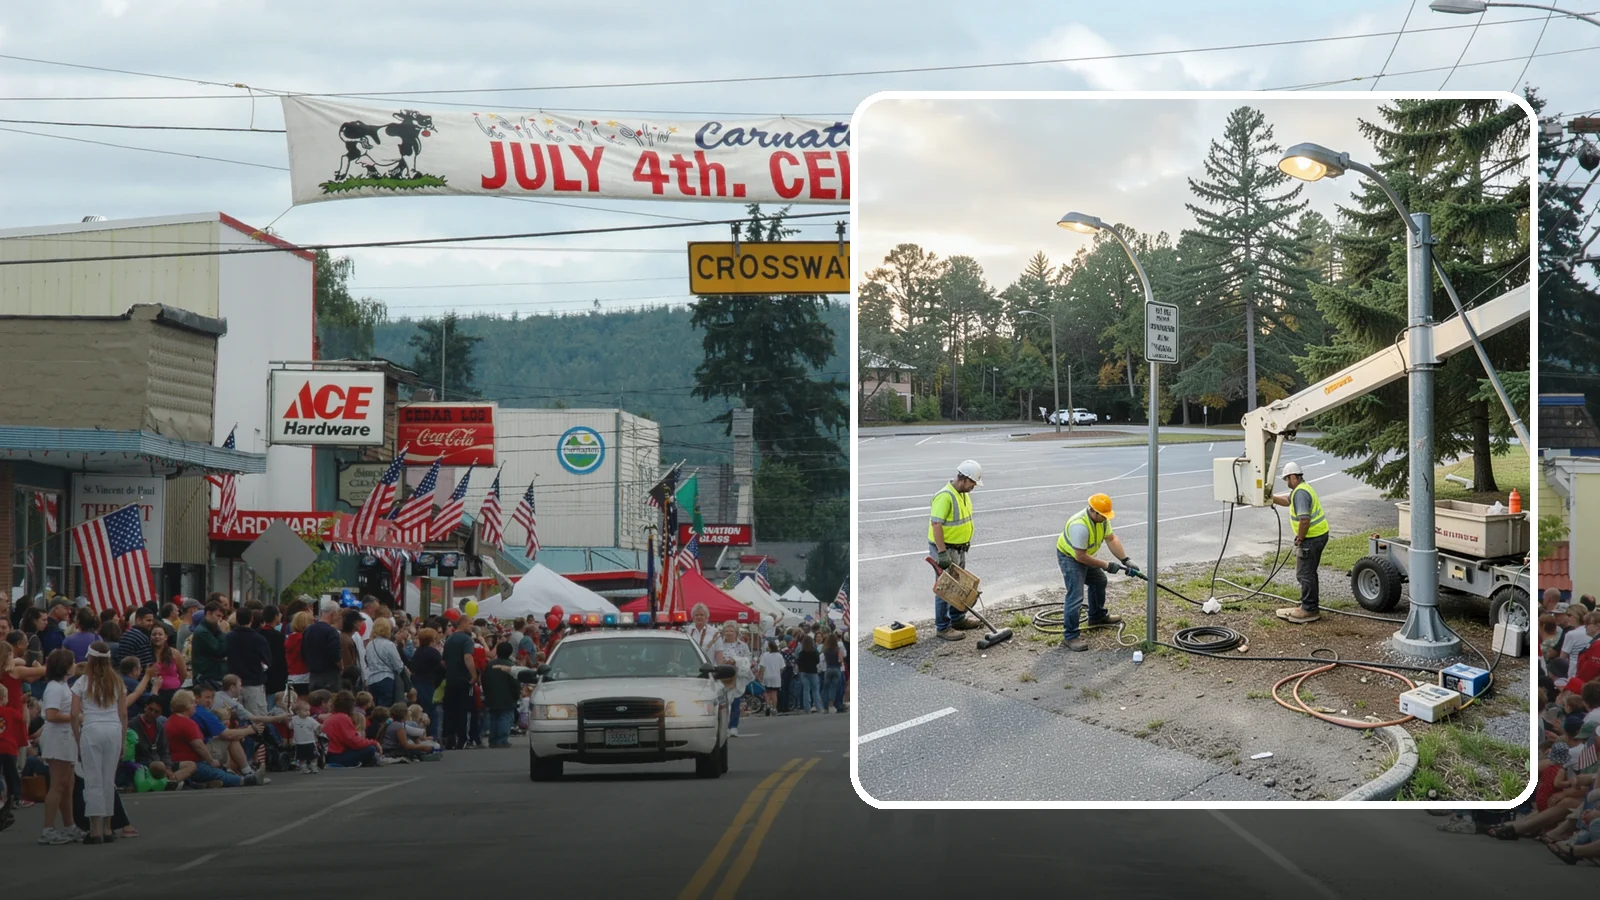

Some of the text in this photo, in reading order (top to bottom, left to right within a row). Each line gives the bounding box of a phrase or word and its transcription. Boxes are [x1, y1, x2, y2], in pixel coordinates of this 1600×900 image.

[695, 121, 850, 149] Carnat
[481, 141, 605, 192] JULY
[632, 150, 746, 198] 4th.
[697, 254, 850, 279] CROSSWA
[283, 380, 373, 420] ACE
[405, 409, 452, 422] CEDAR
[284, 421, 370, 436] Hardware
[416, 428, 477, 447] Coca-Cola
[353, 467, 385, 479] Simpl
[95, 485, 124, 494] Vincent
[126, 486, 135, 494] de
[137, 486, 155, 495] Paul
[688, 526, 741, 535] CRNATION
[699, 535, 730, 543] GLASS
